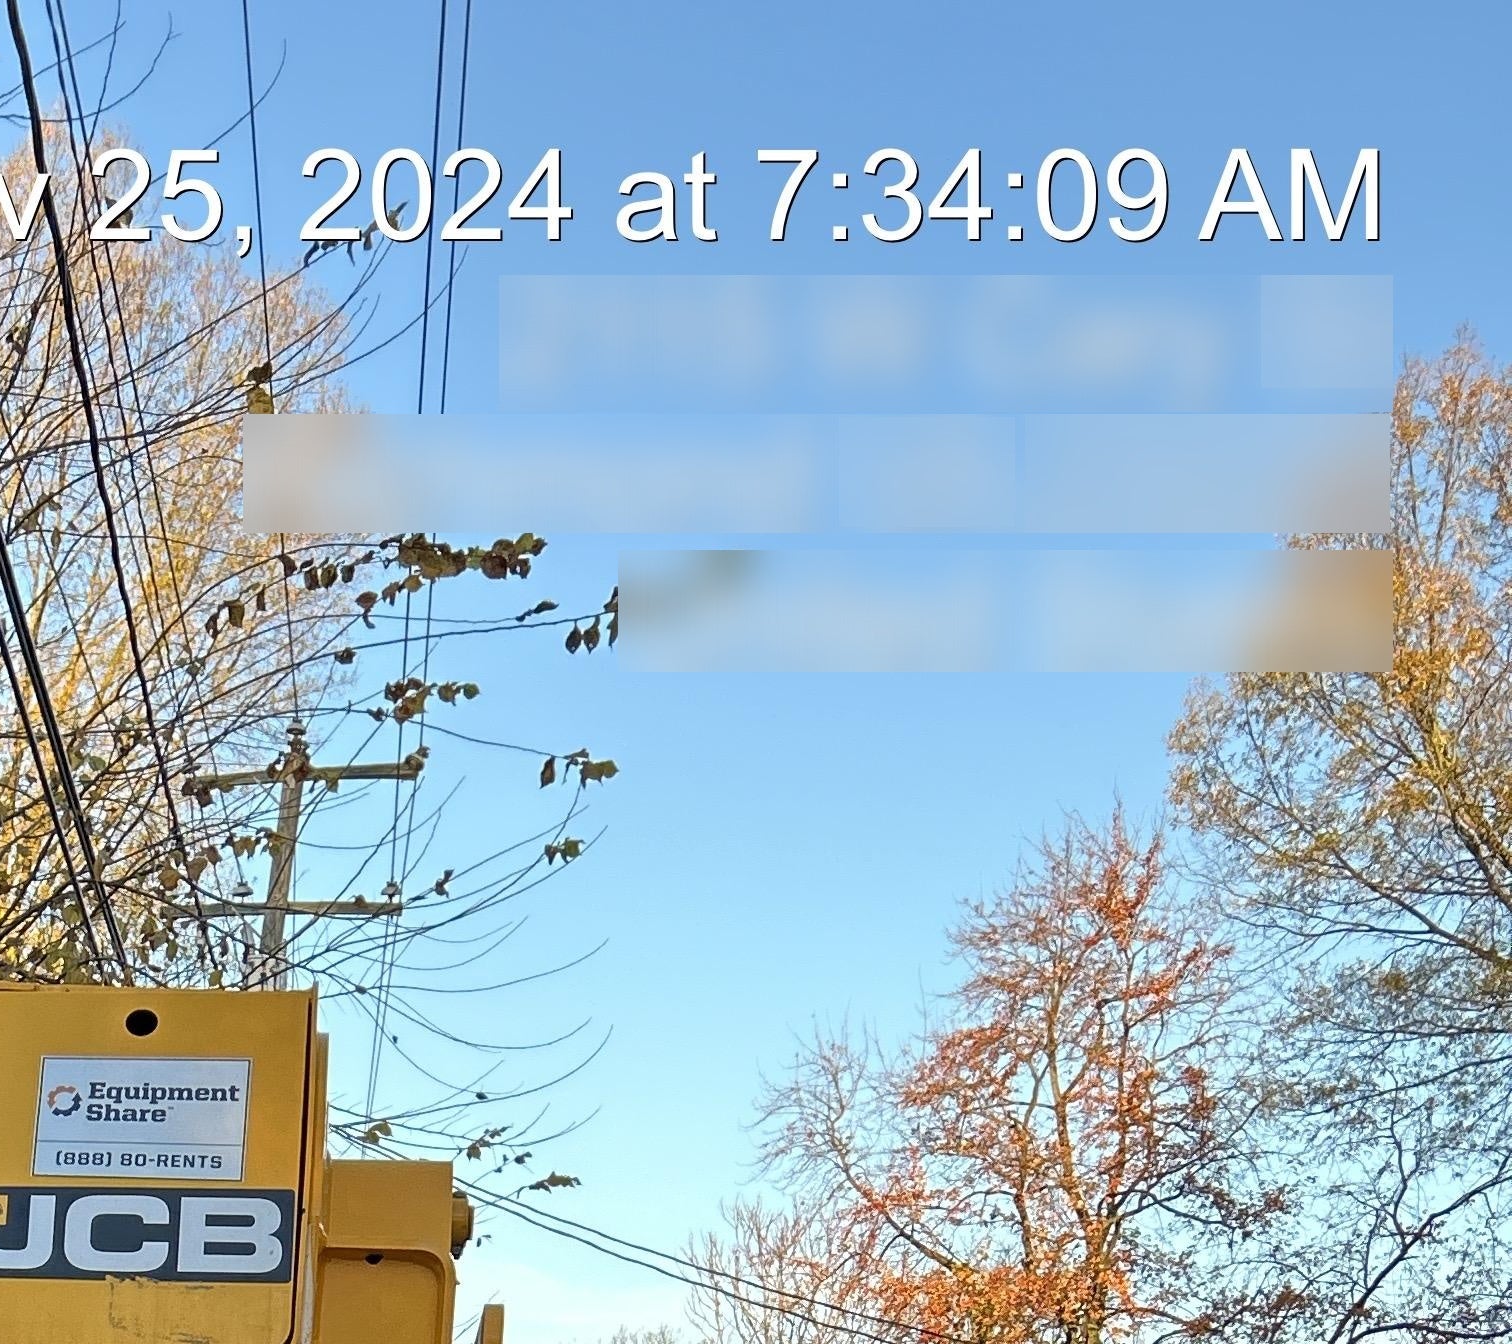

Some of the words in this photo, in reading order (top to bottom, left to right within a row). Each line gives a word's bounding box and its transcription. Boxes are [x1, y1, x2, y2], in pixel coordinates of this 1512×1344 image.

[88, 1082, 239, 1104] Equipment
[86, 1103, 167, 1123] Share
[55, 1150, 112, 1168] (888)
[120, 1152, 223, 1170] 80-RENTS
